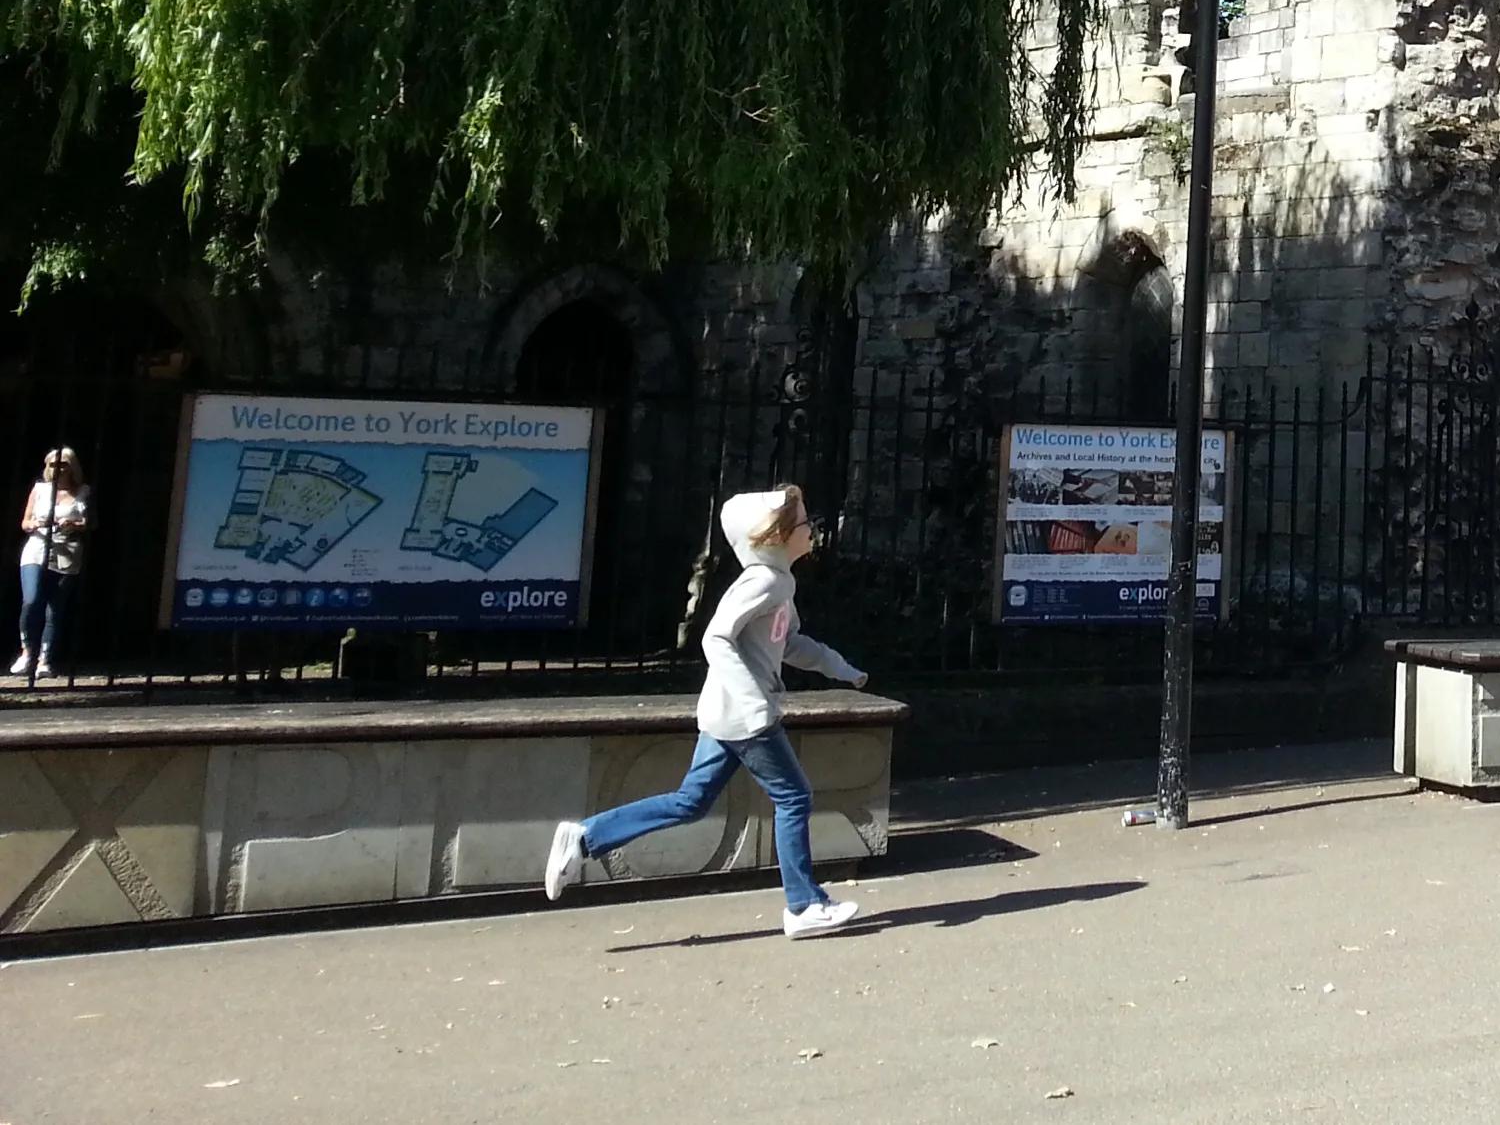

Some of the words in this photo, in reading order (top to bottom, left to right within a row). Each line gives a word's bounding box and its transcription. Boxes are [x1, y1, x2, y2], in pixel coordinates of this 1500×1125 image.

[232, 405, 356, 432] Welcome
[364, 413, 391, 433] to
[398, 411, 457, 435] York
[464, 414, 559, 442] Explore
[1016, 428, 1093, 446] Welcome
[1099, 432, 1115, 447] to
[1120, 431, 1156, 448] York
[1160, 433, 1219, 450] Exre
[1016, 451, 1052, 461] Archives
[1055, 453, 1070, 461] and
[1074, 453, 1095, 462] Local
[1098, 454, 1125, 464] History
[1128, 455, 1136, 463] at
[1138, 455, 1152, 463] the
[1155, 455, 1176, 463] heart
[480, 586, 567, 612] explore
[1119, 583, 1168, 603] explor
